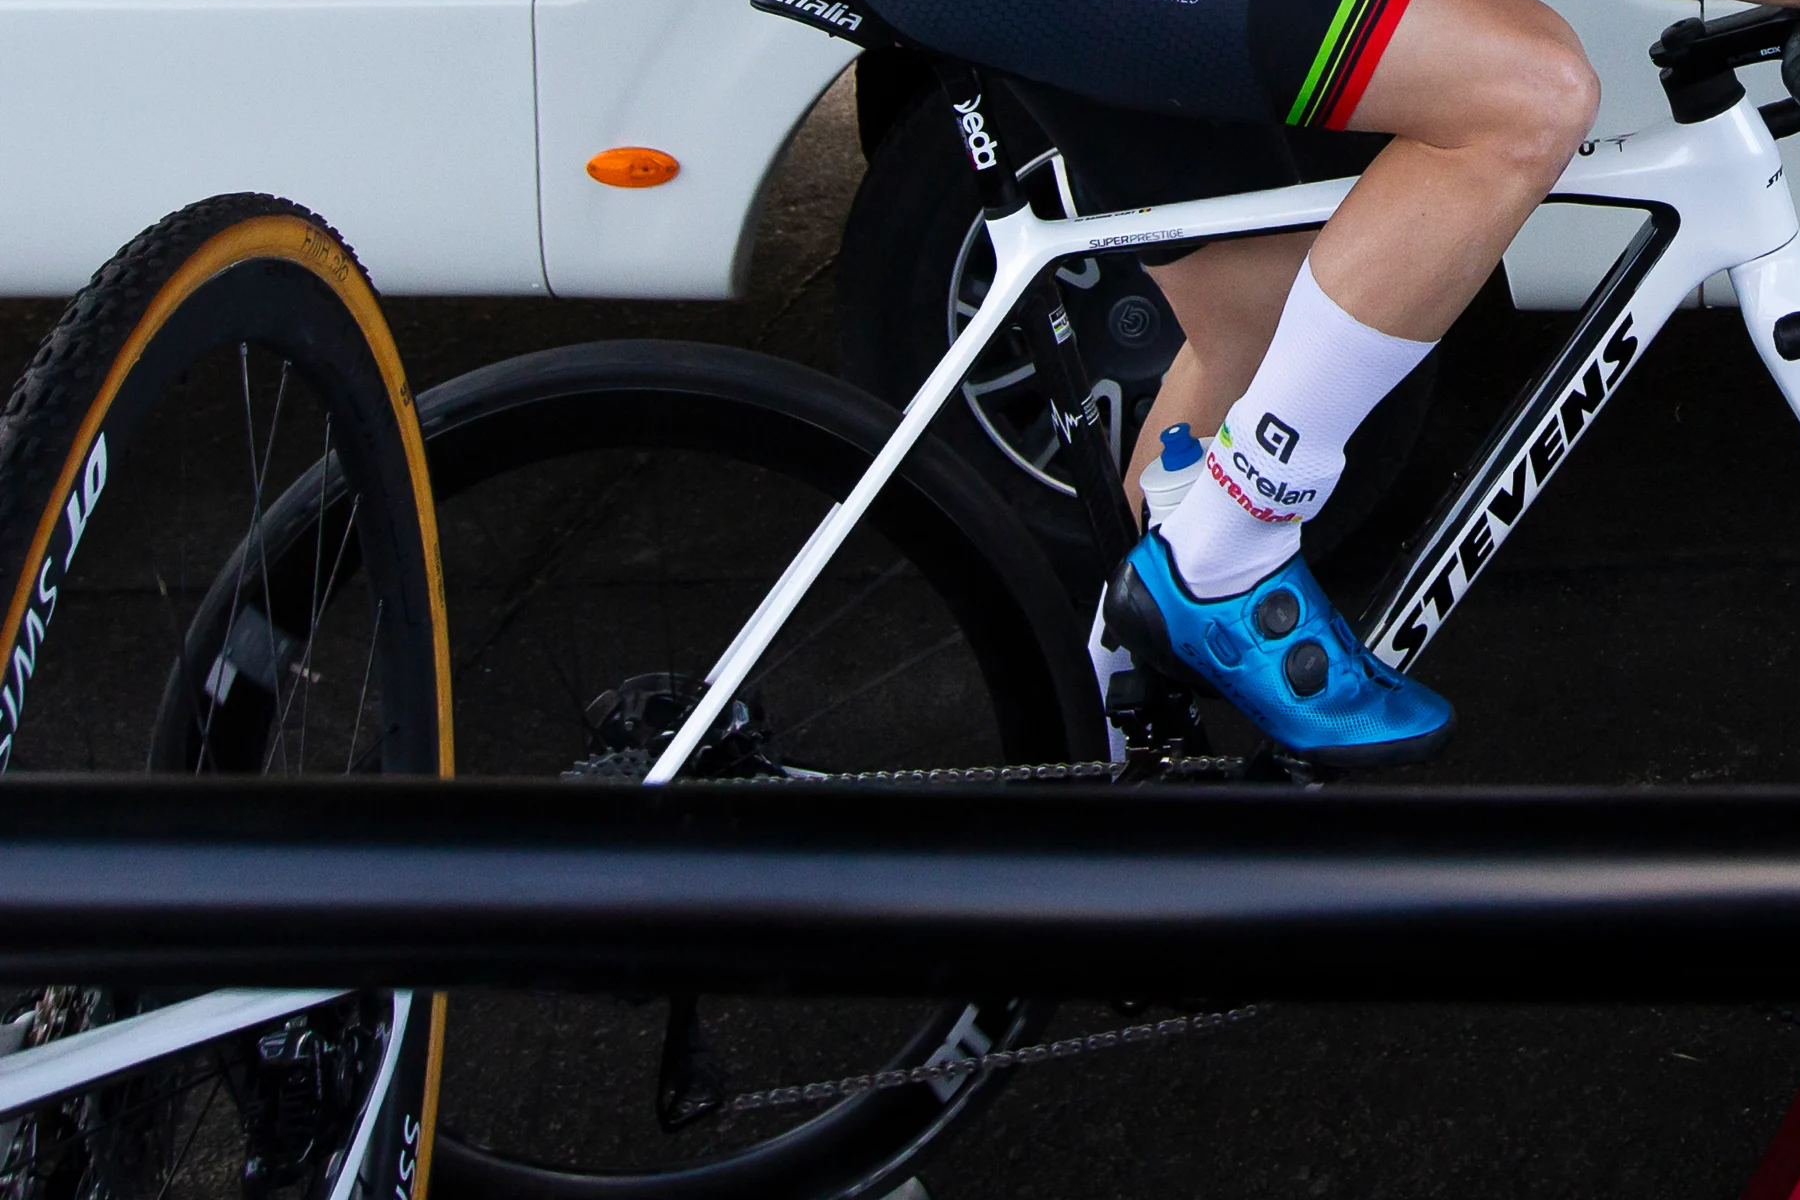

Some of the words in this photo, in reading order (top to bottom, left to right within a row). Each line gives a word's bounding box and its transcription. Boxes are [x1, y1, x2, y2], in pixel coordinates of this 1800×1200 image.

[1089, 228, 1184, 248] SUPERPRESTIGE
[1233, 452, 1316, 505] crelan
[1391, 311, 1639, 674] STEVENS
